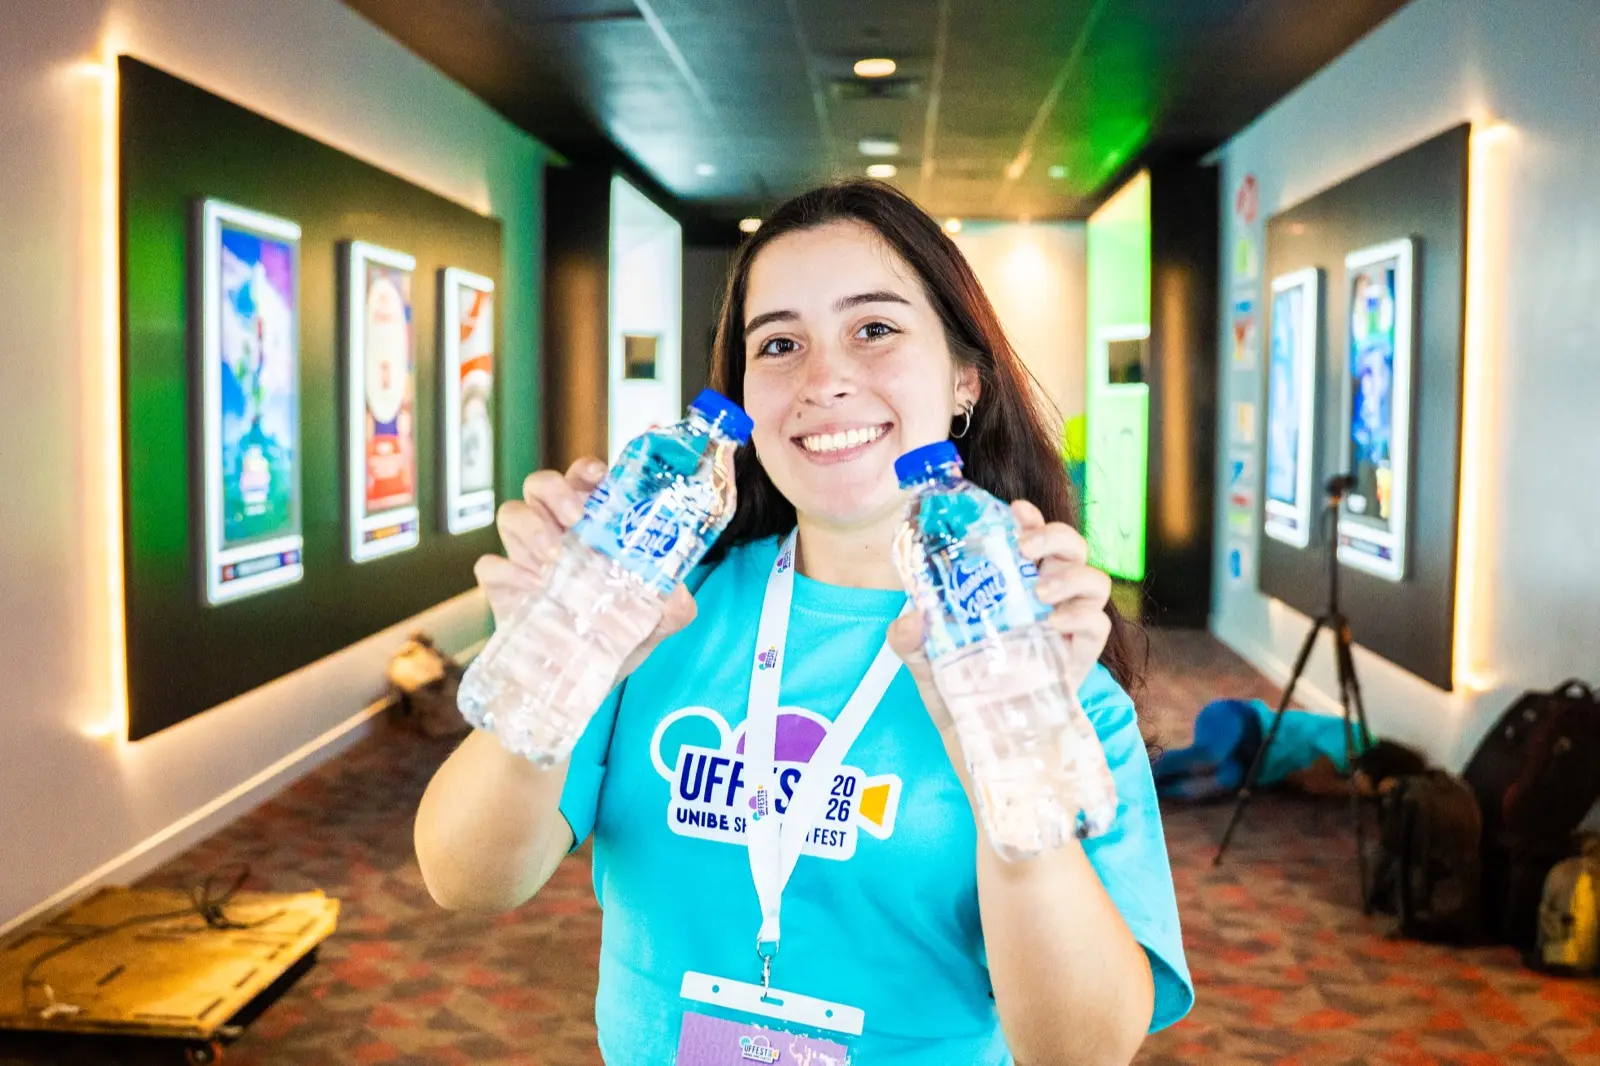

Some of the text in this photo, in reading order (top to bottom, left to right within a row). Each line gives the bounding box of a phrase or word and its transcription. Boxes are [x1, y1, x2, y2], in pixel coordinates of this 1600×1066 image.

[680, 753, 802, 814] UFFS
[830, 774, 856, 797] 20
[757, 794, 765, 816] UFFEST
[825, 798, 851, 822] 26
[676, 807, 729, 831] UNIBE
[813, 827, 847, 847] FEST
[744, 1045, 768, 1056] UFFEST
